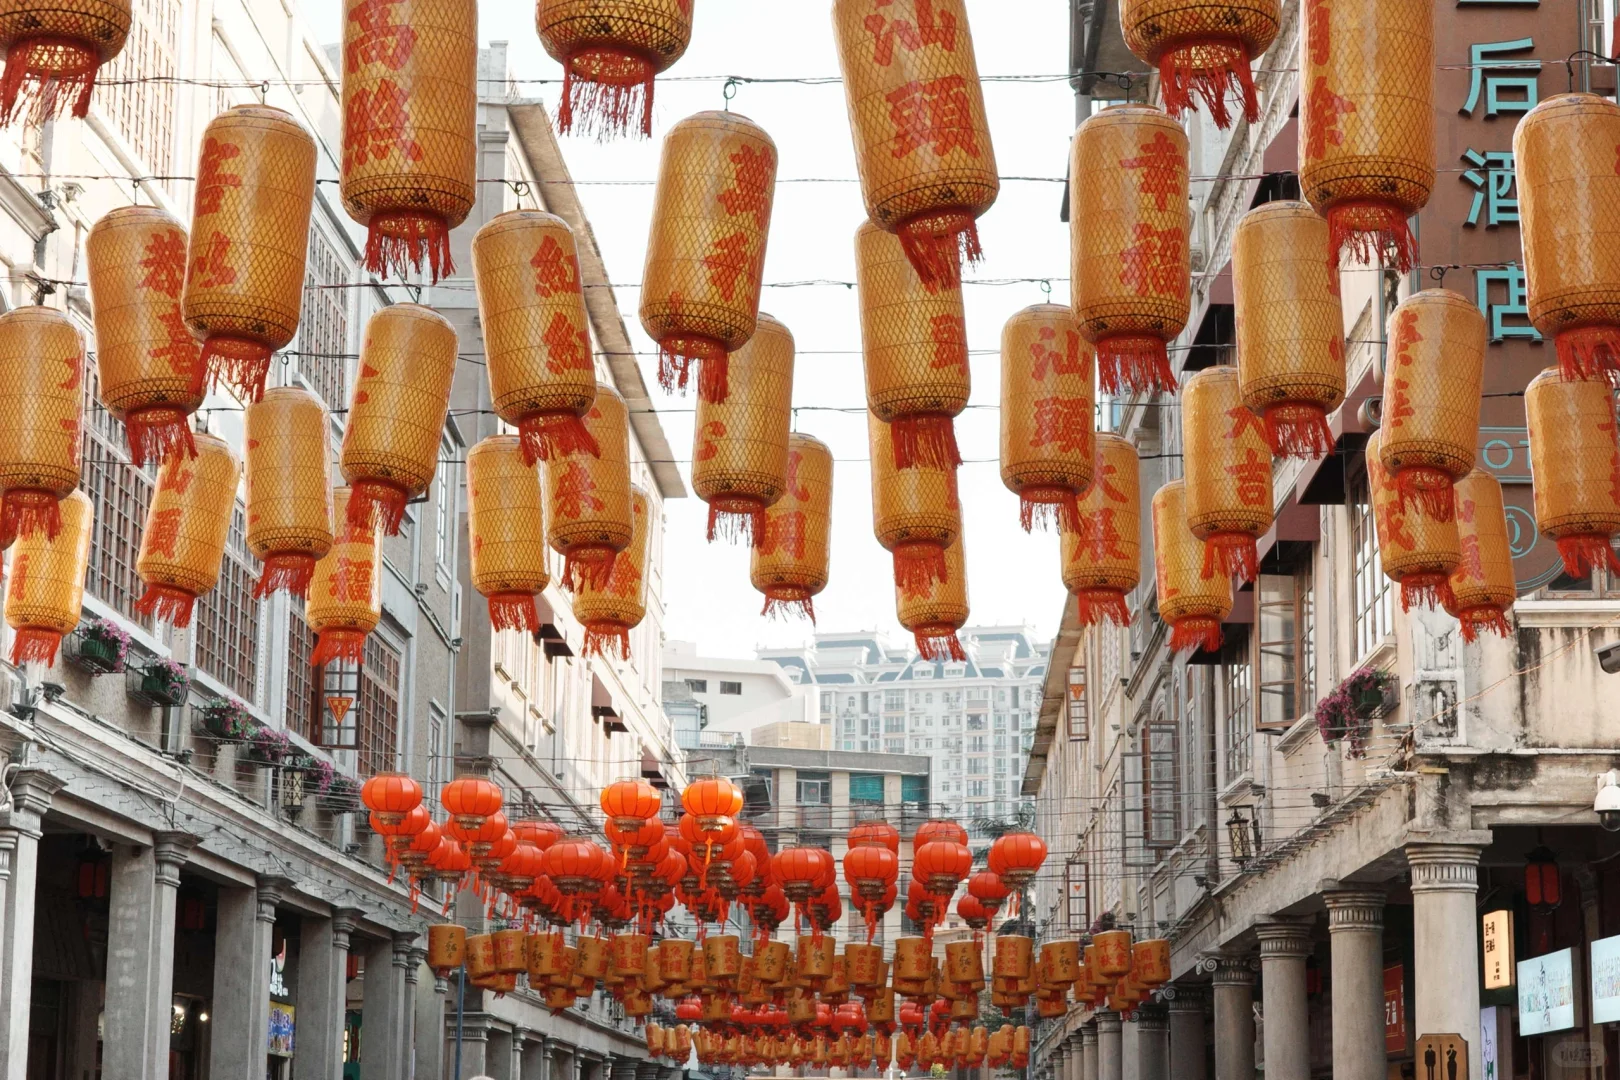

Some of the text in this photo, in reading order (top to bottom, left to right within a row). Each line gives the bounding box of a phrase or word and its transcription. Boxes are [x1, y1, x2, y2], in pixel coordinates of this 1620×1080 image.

[1119, 131, 1186, 301] 幸福
[1456, 0, 1543, 345] 后酒店
[1029, 326, 1091, 460] 汕頭
